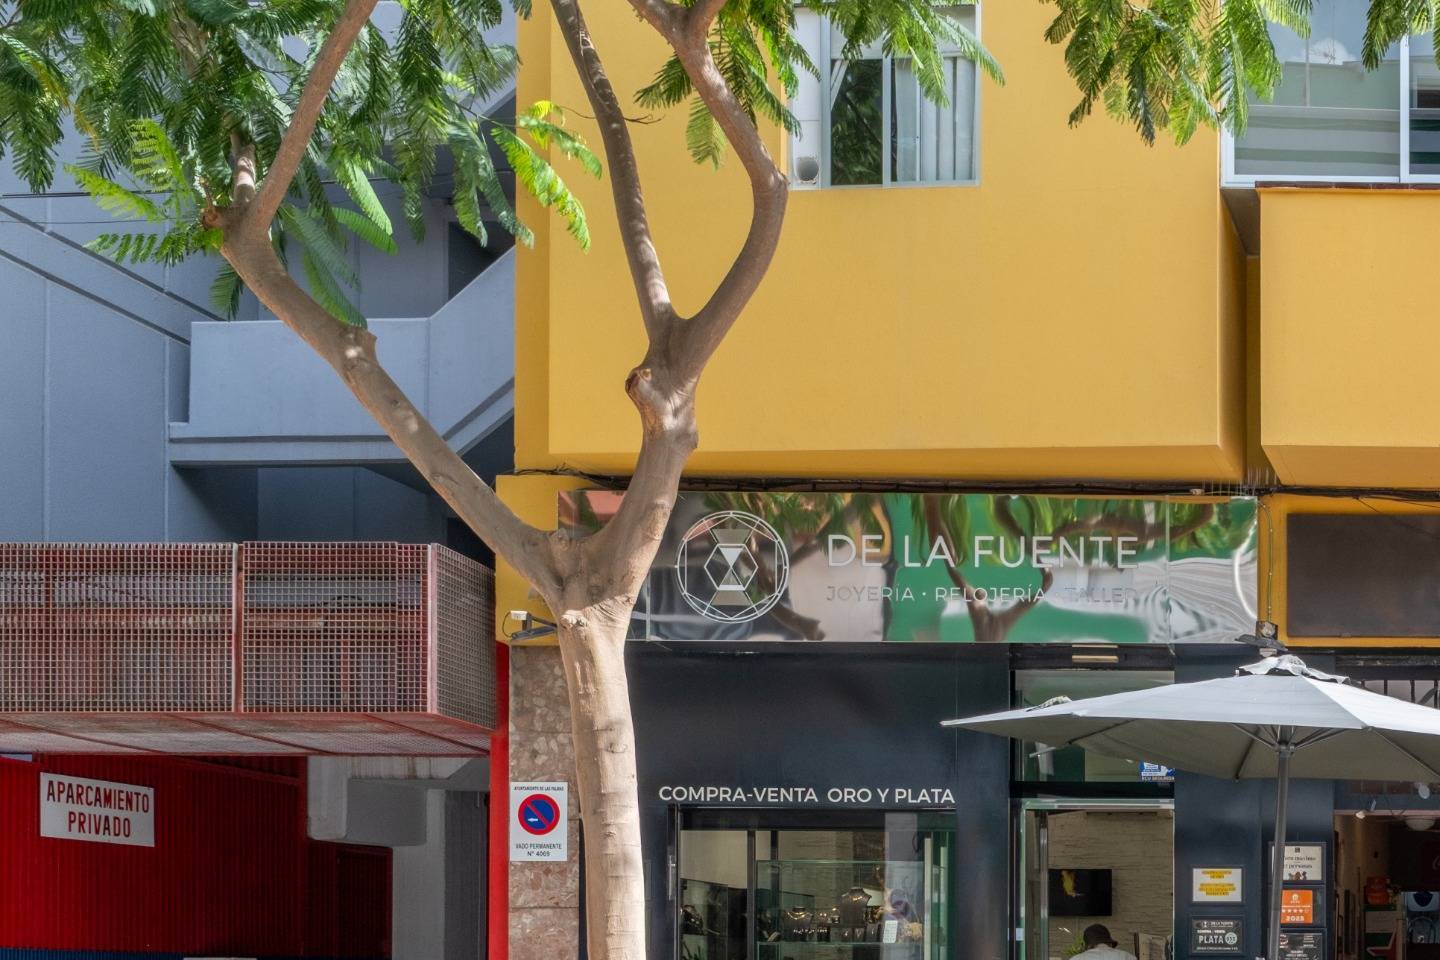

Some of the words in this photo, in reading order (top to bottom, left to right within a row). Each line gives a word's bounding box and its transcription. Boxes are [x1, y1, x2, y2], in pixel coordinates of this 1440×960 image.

[827, 533, 884, 568] DE
[903, 534, 955, 568] LA
[974, 535, 1139, 569] FUENTE
[827, 583, 915, 602] JOYERÍA
[935, 583, 1045, 603] RELOJERÍA
[46, 780, 150, 813] APARCAMIENTO
[658, 785, 819, 802] COMPRA-VENTA
[827, 787, 873, 803] ORO
[876, 788, 890, 803] Y
[894, 788, 956, 804] PLATA
[68, 811, 131, 838] PRIVADO
[1198, 935, 1224, 944] PLATA
